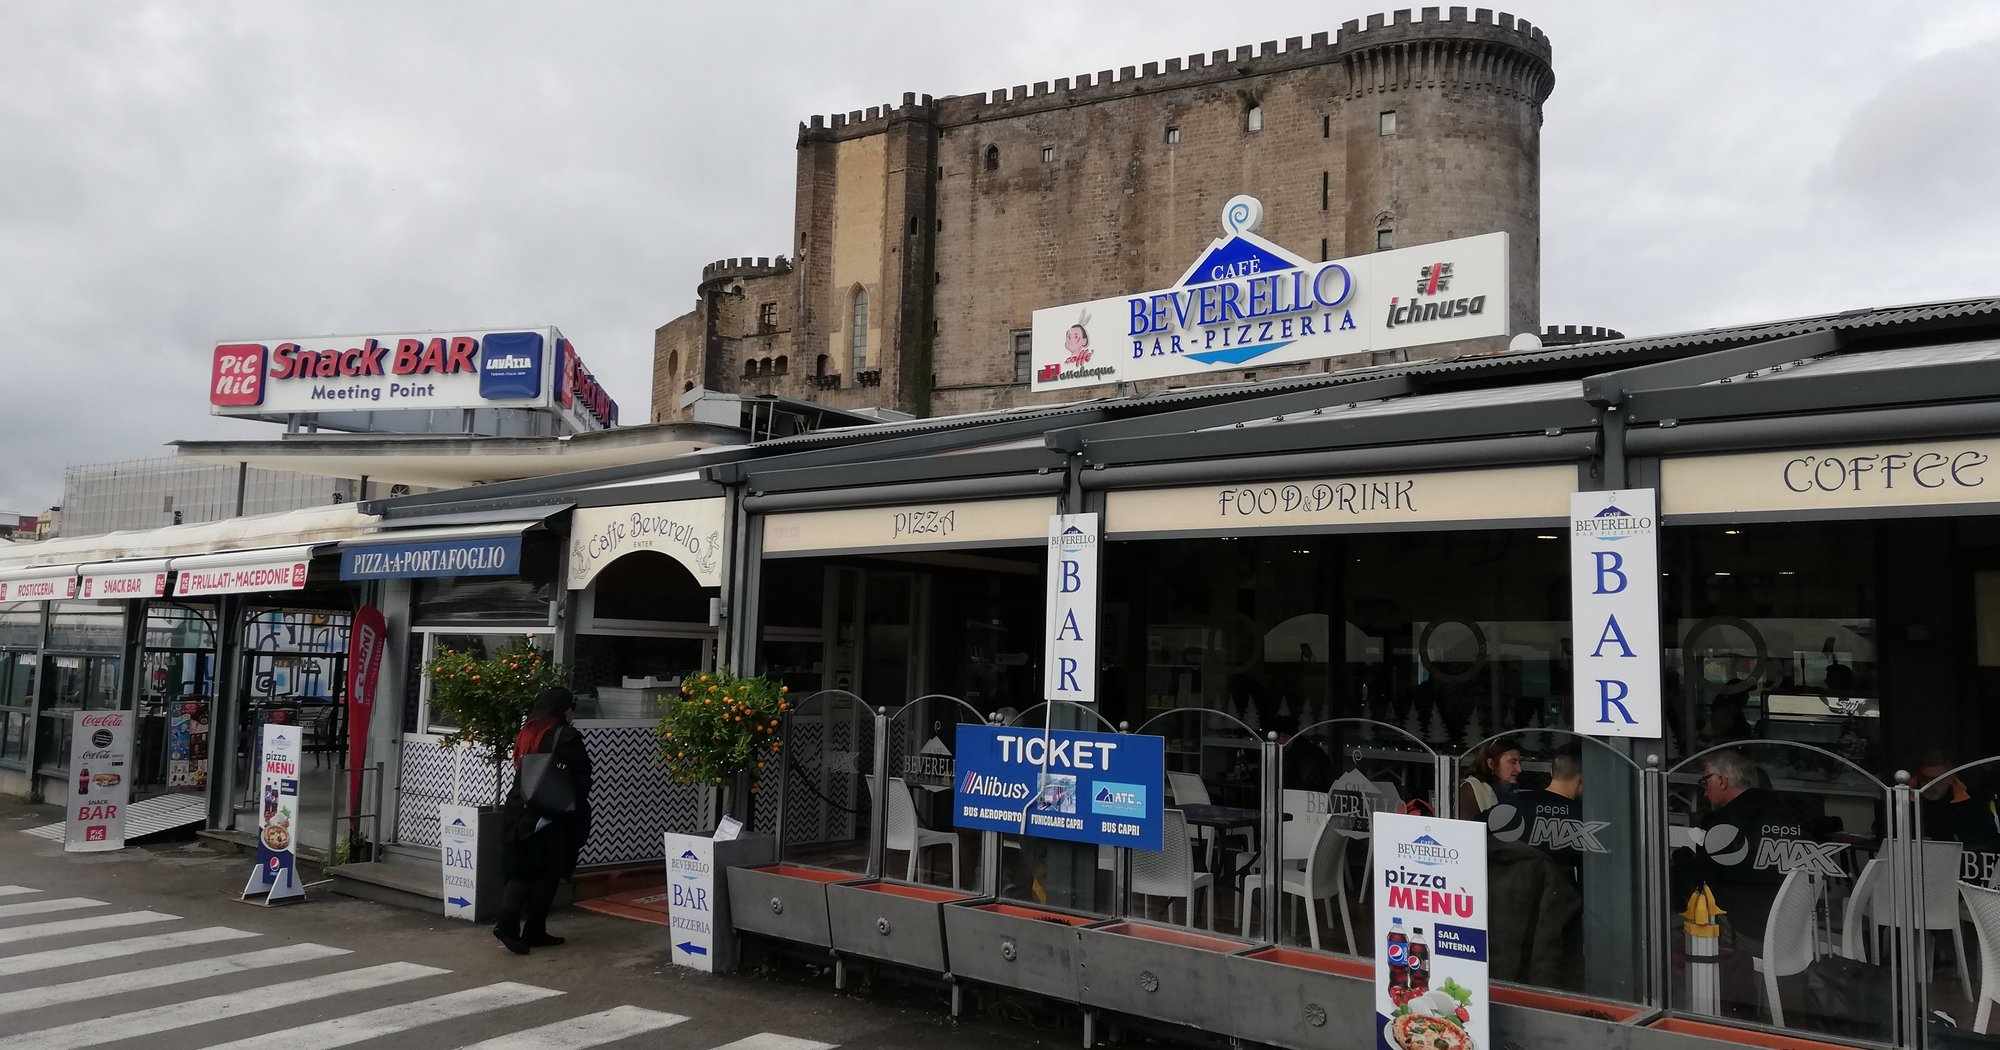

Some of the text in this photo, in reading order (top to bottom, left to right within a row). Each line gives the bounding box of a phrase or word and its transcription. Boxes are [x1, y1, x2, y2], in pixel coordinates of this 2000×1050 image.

[1211, 255, 1261, 281] CAFÈ
[1128, 264, 1352, 336] BEVERELLO
[1386, 295, 1486, 329] ichnusa
[269, 336, 479, 379] Snack BAR
[486, 354, 532, 369] LAVAZZA
[1038, 364, 1116, 383] Passalacqua
[311, 382, 435, 401] Meeting Point
[1783, 451, 1988, 493] COFFEE
[892, 510, 955, 539] PIZZA
[1575, 517, 1651, 532] BEVERELLO
[588, 512, 700, 559] Caffe Beverello
[633, 540, 653, 548] ENTER
[18, 582, 54, 596] ROSTICCERIA
[104, 579, 125, 593] SNACK
[127, 578, 141, 592] BAR
[1056, 559, 1084, 692] BAR
[1590, 550, 1639, 725] BAR
[266, 750, 287, 762] pizza
[997, 735, 1117, 771] TICKET
[266, 760, 295, 775] MENÙ
[971, 774, 1022, 799] Alibus
[1114, 792, 1135, 804] ATC
[78, 805, 117, 821] BAR
[963, 806, 1022, 823] BUS AEROPORTO
[1535, 804, 1569, 816] pepsi
[1031, 813, 1083, 830] FUNICOLARE CAPRI
[1101, 821, 1140, 836] BUS CAPRI
[444, 825, 474, 838] BEVERELLO
[1528, 816, 1611, 853] MAX
[1761, 824, 1800, 837] pepsi
[446, 847, 473, 870] BAR
[1398, 843, 1459, 860] BEVERELLO
[1753, 837, 1851, 878] MAX
[671, 858, 709, 874] BEVERELLO
[445, 875, 474, 889] PIZZERIA
[1385, 865, 1447, 889] pizza
[673, 883, 709, 911] BAR
[1388, 886, 1473, 918] MENÙ
[672, 916, 711, 934] PIZZERIA
[1438, 930, 1460, 940] SALA
[1438, 940, 1476, 954] INTERNA
